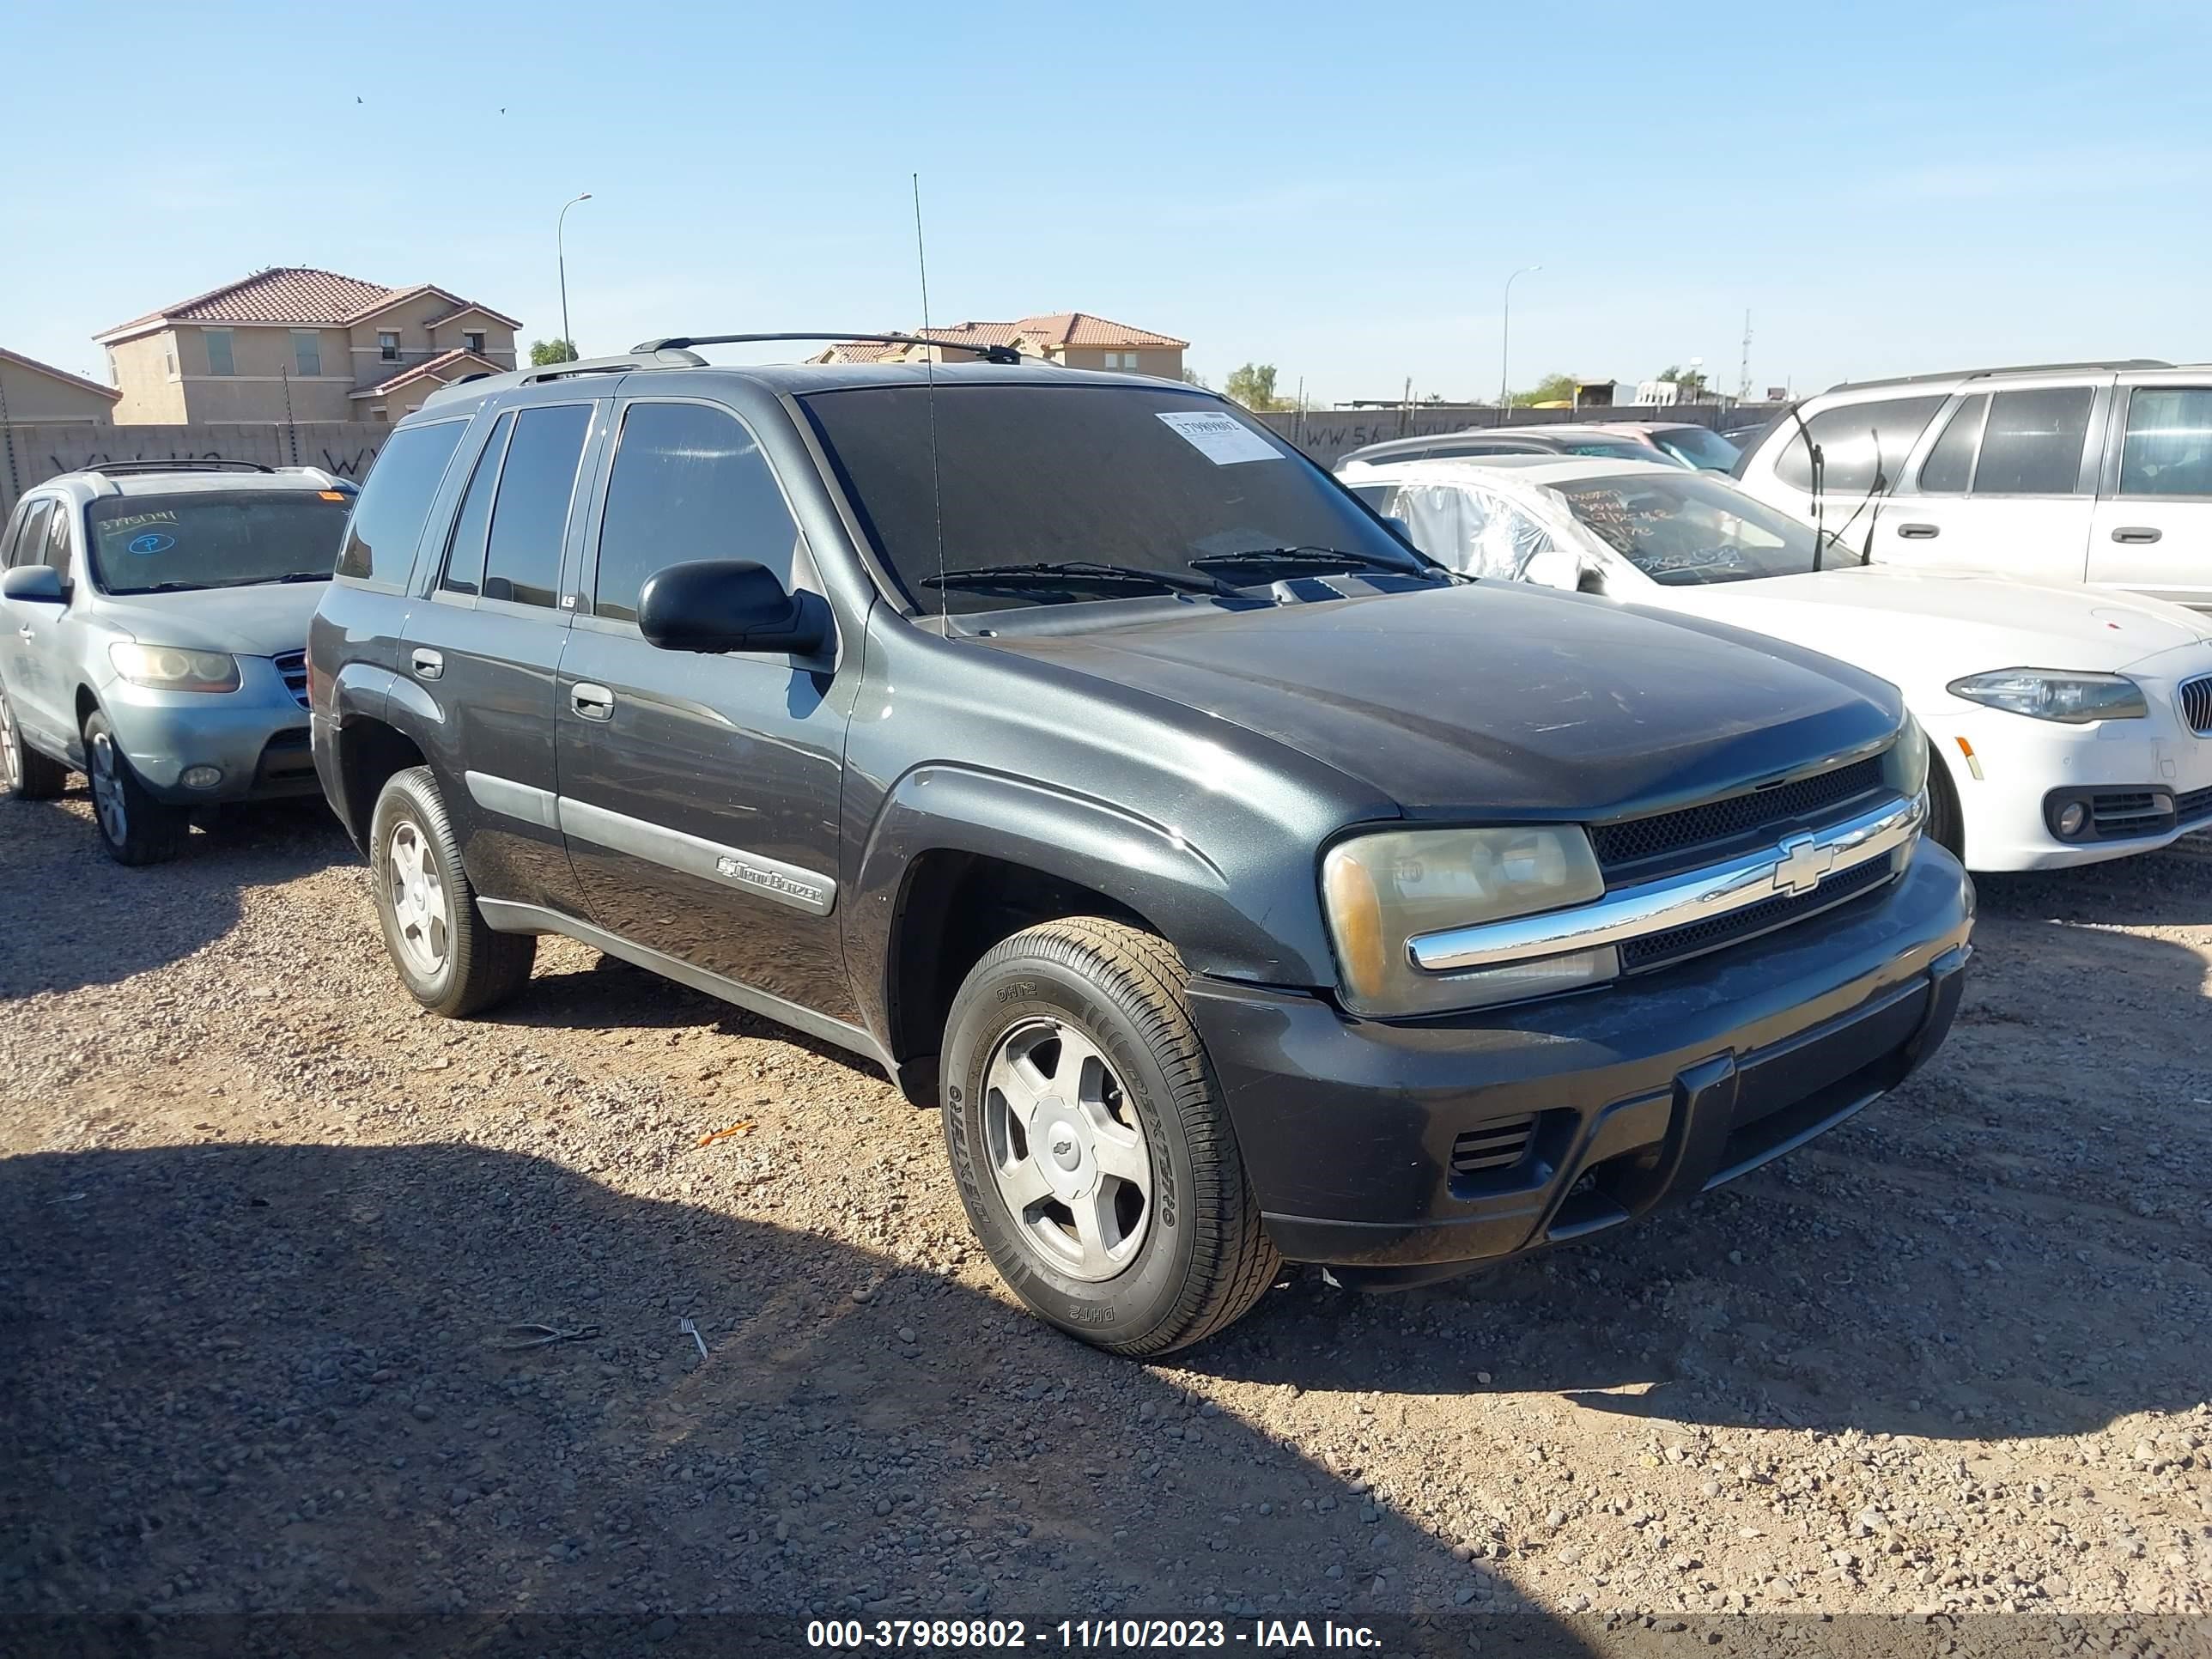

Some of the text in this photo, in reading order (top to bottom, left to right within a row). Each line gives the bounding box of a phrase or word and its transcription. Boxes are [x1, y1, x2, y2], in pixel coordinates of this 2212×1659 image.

[1176, 422, 1240, 434] 37989802
[561, 595, 576, 608] LS
[996, 981, 1038, 1003] DHT2
[949, 1085, 991, 1224] DEXTERO
[1069, 1304, 1115, 1322] DHT2
